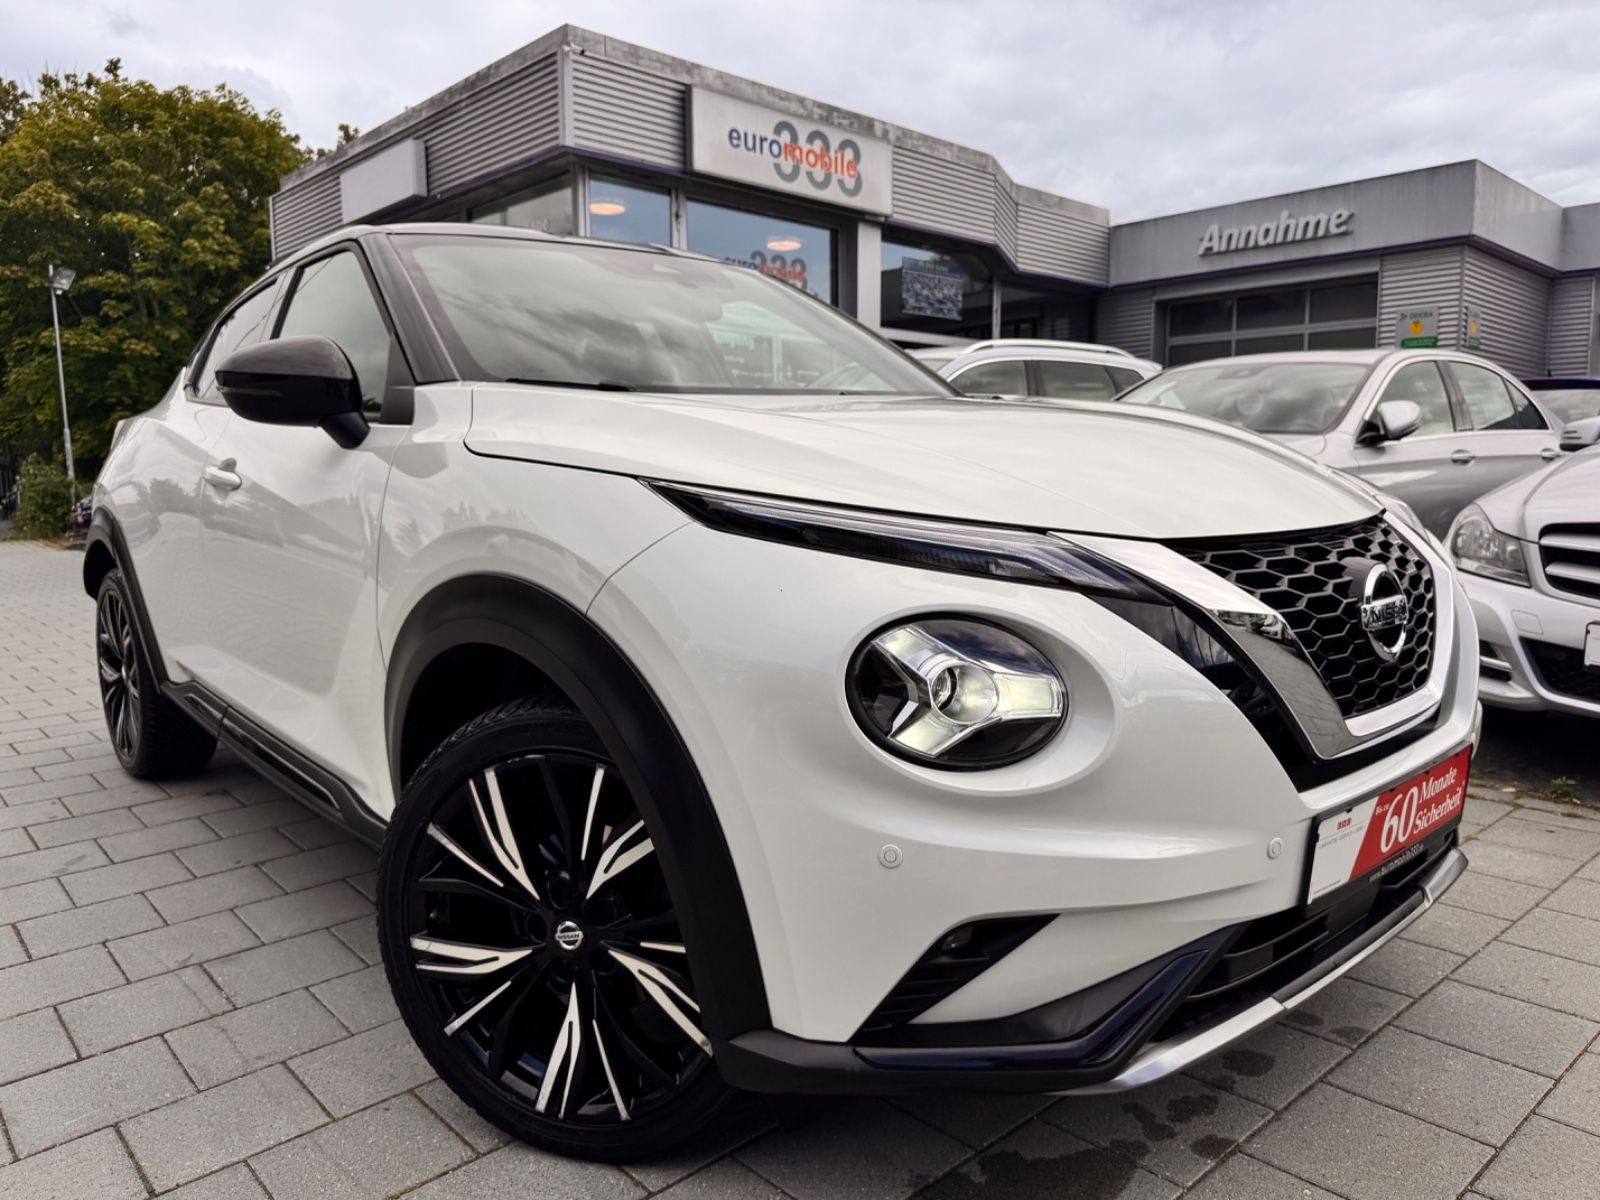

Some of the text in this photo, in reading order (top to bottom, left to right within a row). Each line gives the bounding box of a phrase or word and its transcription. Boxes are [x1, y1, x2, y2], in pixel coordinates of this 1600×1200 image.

[728, 127, 858, 179] euromobile
[773, 121, 862, 198] 333
[1198, 208, 1353, 256] Annahme
[1419, 767, 1457, 803] Monate
[1380, 786, 1418, 853] 60
[1413, 787, 1462, 834] Sicherheit
